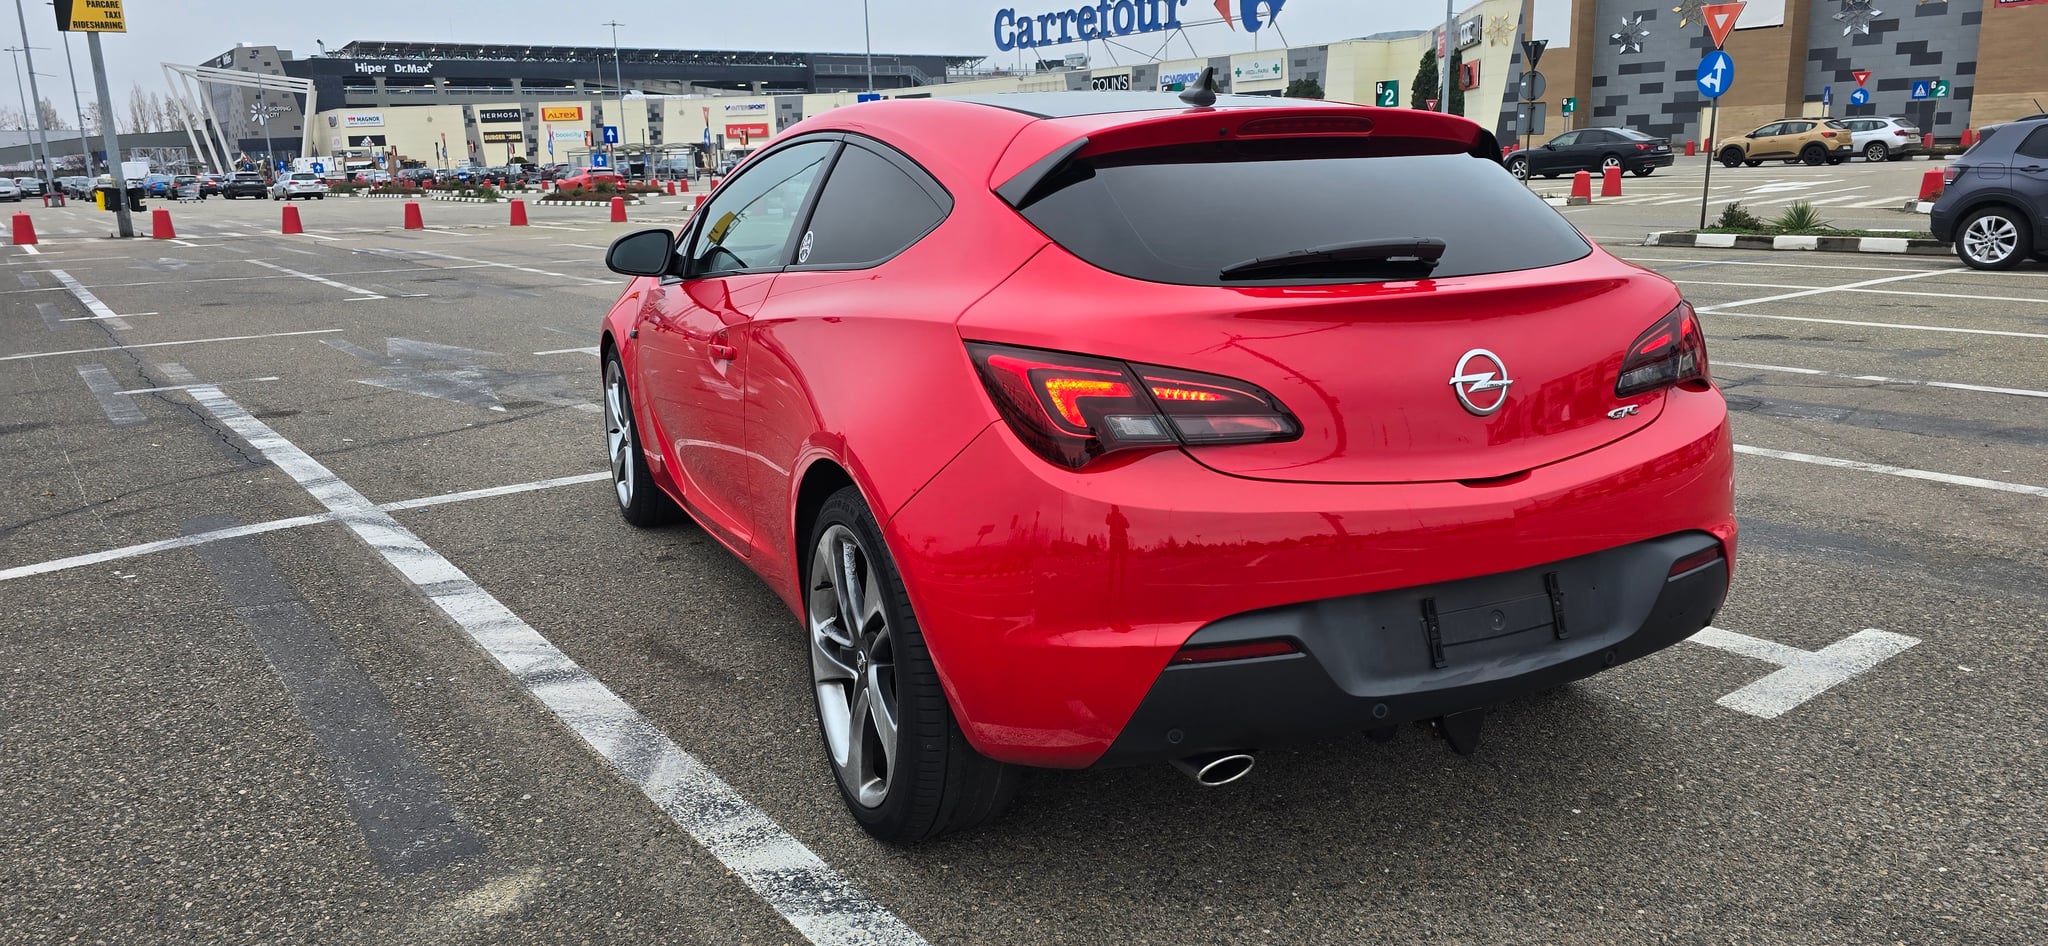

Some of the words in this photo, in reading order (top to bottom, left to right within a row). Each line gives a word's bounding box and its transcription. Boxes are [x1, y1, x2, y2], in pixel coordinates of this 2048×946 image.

[86, 0, 120, 8] PARCARE
[104, 11, 122, 19] TAXI
[72, 20, 124, 29] RIDESHARING
[994, 0, 1188, 51] Carrefour
[354, 62, 387, 75] Hiper
[1091, 74, 1129, 92] COLIN'S
[1377, 82, 1383, 94] G
[1385, 89, 1394, 106] 2
[1937, 85, 1947, 97] 2
[1569, 101, 1574, 111] 1
[1607, 403, 1640, 419] GTC
